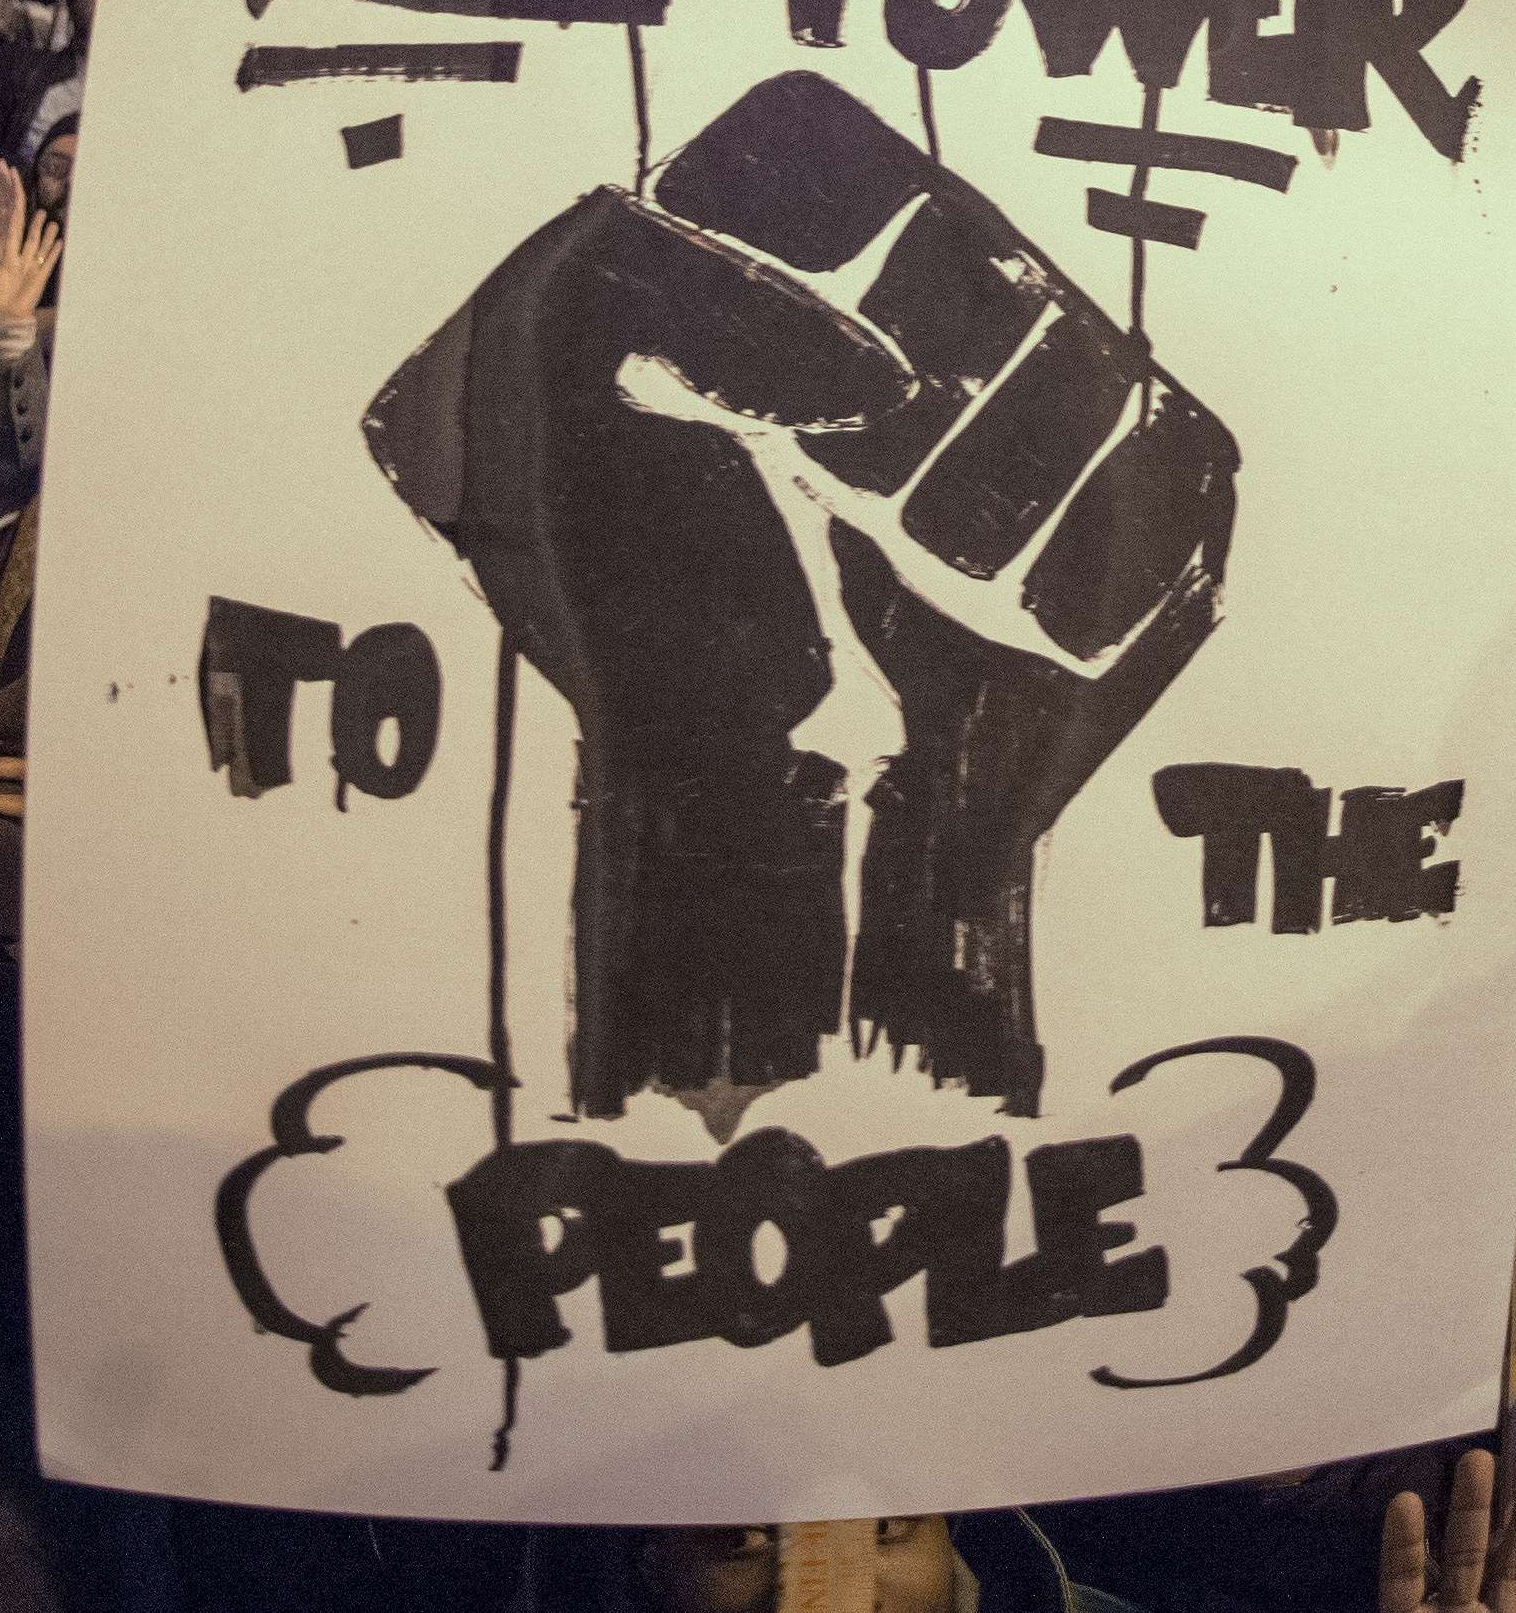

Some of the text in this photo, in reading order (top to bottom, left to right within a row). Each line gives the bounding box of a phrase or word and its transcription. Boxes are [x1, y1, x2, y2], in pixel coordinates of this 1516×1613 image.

[198, 596, 1465, 936] TO THE
[446, 1125, 1169, 1368] PEOPLE
